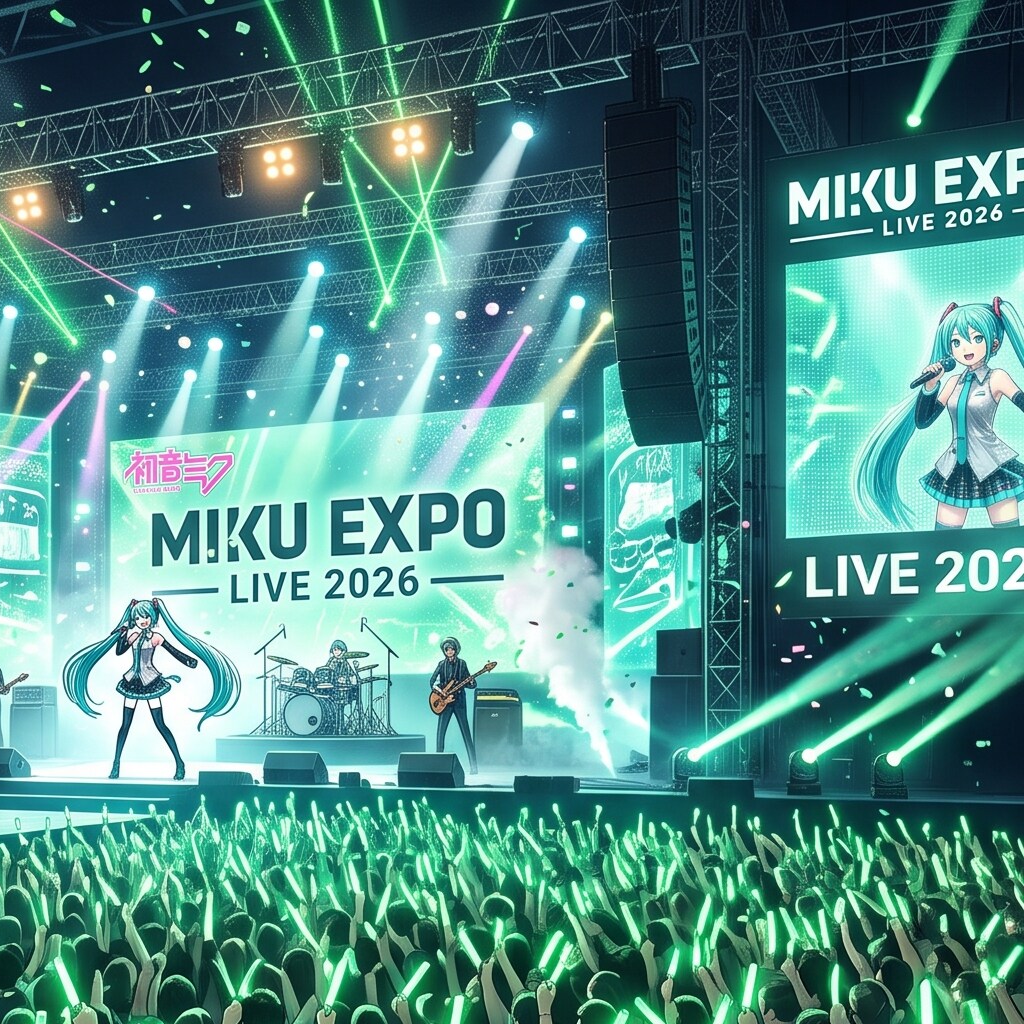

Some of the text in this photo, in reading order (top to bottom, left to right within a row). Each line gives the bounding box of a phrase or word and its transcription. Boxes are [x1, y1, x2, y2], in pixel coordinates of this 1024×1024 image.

[788, 163, 917, 225] MIKU
[882, 203, 1004, 237] LIVE 2026
[123, 448, 235, 497] 初音ミク
[151, 488, 506, 567] MIKU EXPO
[230, 565, 420, 604] LIVE 2026
[805, 546, 1024, 598] LIVE 202
